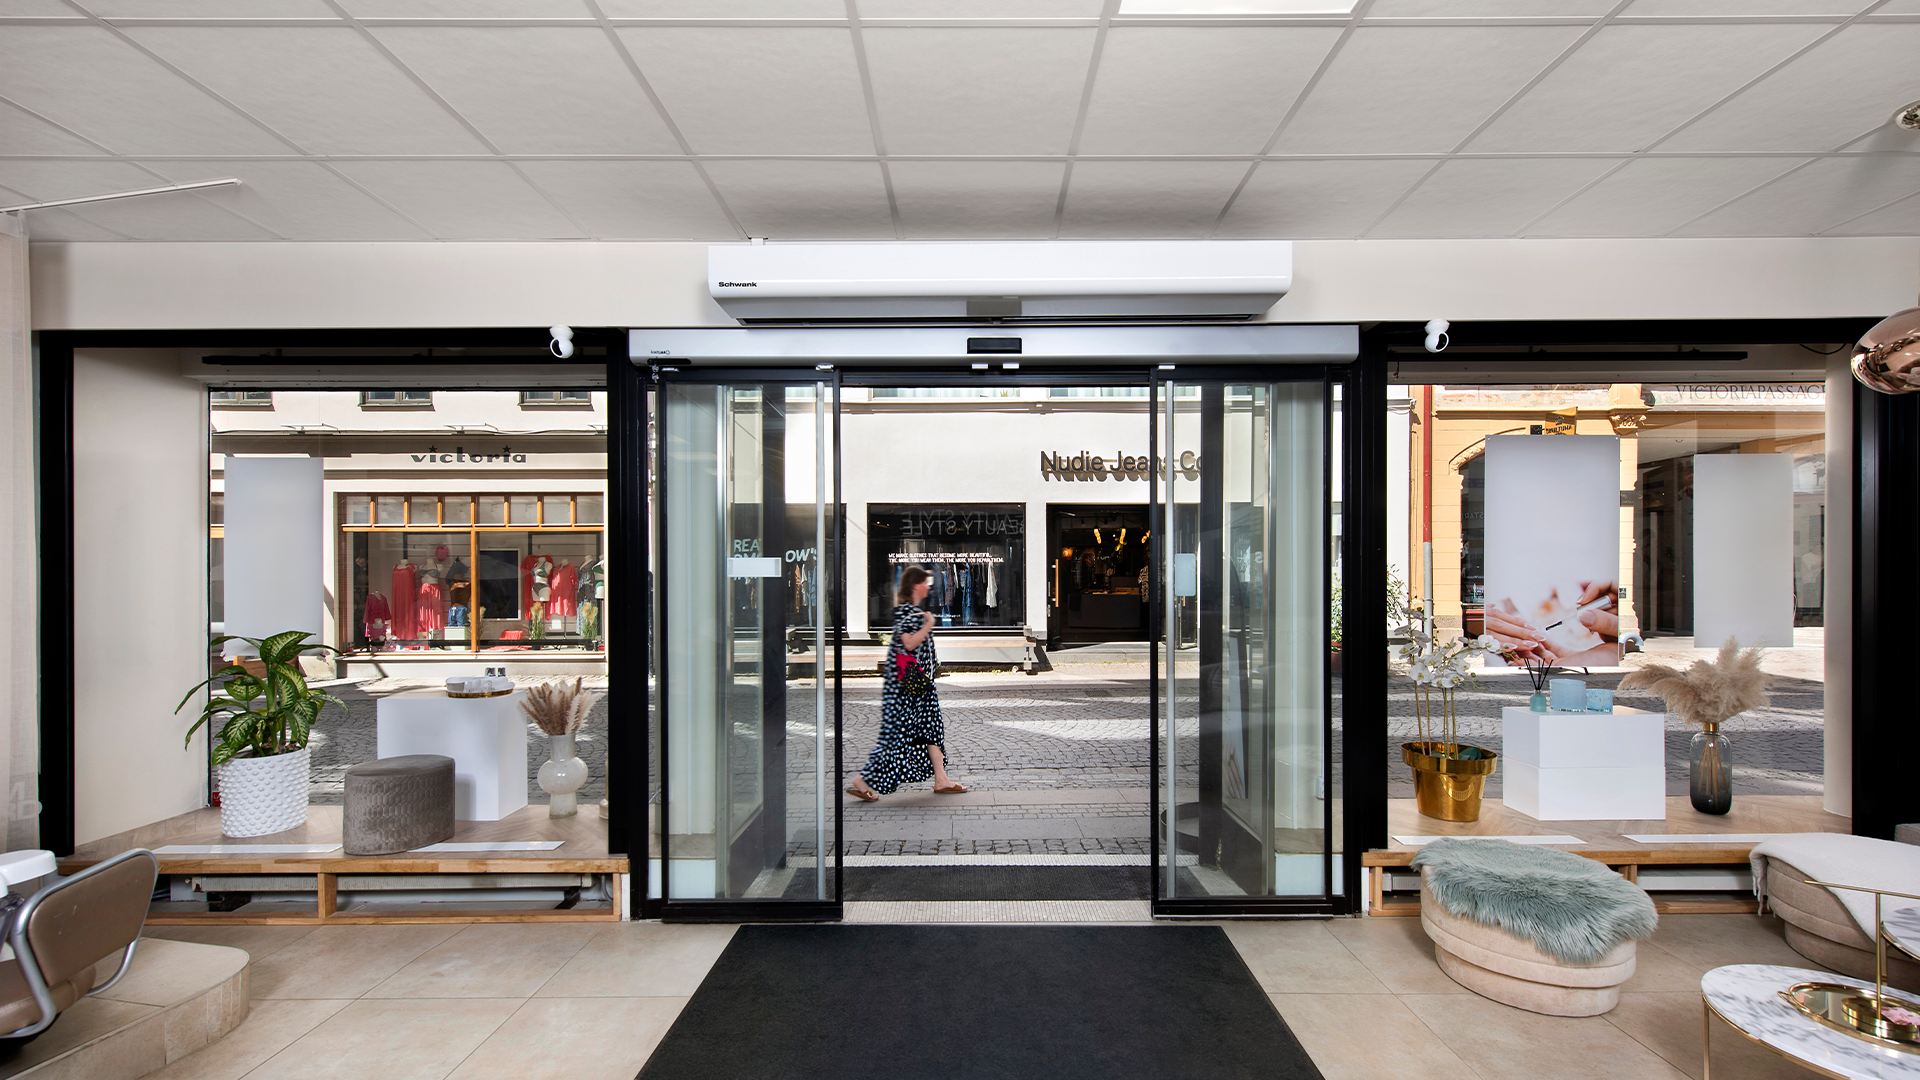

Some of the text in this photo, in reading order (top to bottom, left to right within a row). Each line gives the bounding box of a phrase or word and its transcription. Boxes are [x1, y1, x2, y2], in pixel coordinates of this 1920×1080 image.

[411, 445, 526, 463] victoria
[1041, 450, 1103, 471] Nudie
[1110, 450, 1168, 471] Jea
